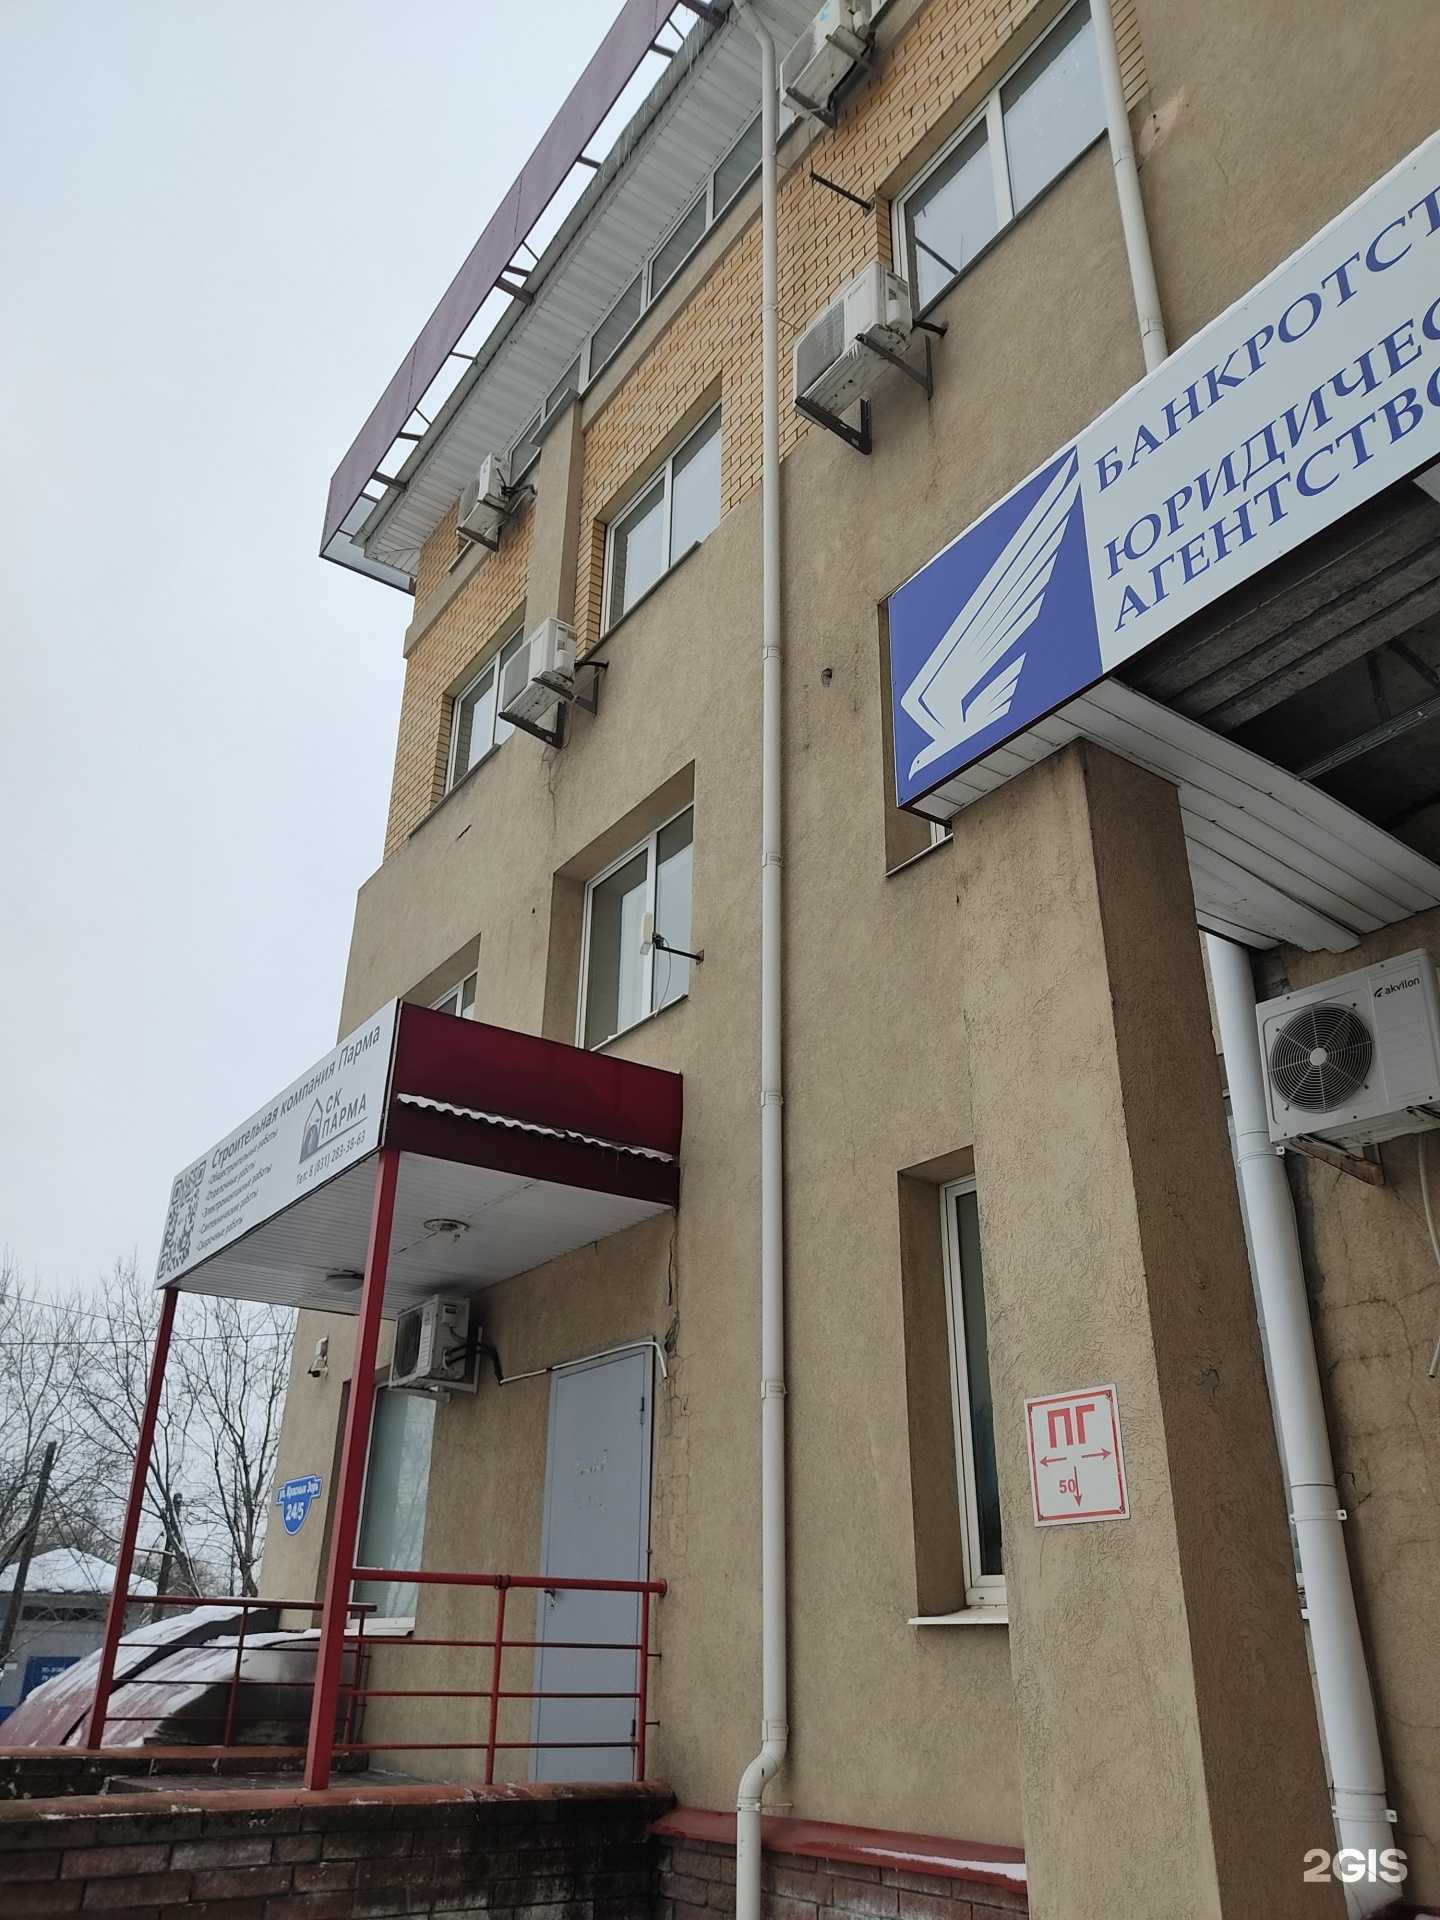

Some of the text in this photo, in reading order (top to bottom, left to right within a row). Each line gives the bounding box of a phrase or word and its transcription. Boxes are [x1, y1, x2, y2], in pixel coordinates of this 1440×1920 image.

[1094, 187, 1440, 493] БАНКРОТСТ
[1115, 366, 1440, 631] АГЕНТСТВ
[211, 1025, 380, 1168] Строительная компания Парма
[321, 1093, 367, 1139] ПАРМА
[325, 1088, 343, 1114] СК
[1047, 1404, 1095, 1448] ПГ
[1059, 1478, 1076, 1494] 50
